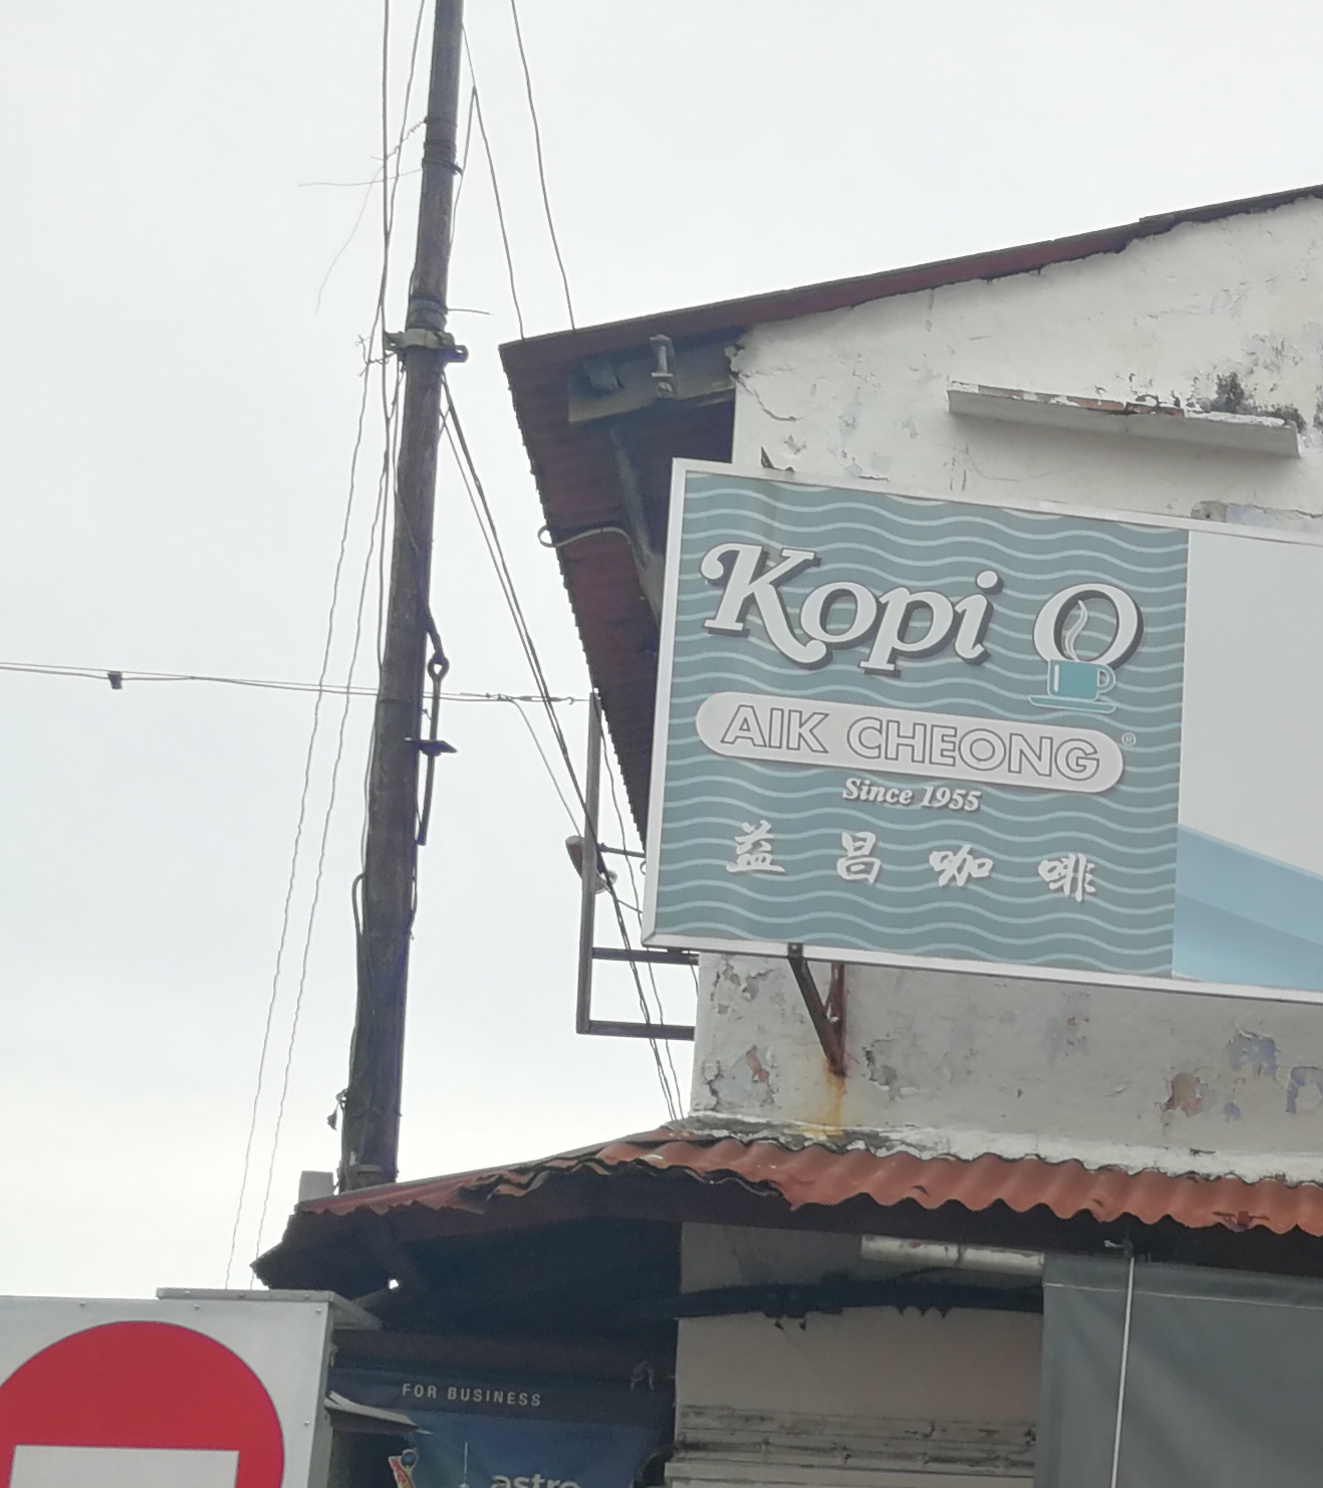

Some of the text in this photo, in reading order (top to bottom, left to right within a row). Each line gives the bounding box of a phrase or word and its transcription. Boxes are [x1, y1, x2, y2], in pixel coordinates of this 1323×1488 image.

[701, 542, 1141, 673] Kopi O
[721, 705, 1100, 780] AIK CHEONG
[842, 778, 981, 812] Since 1955
[402, 1383, 541, 1407] FOR BUSINESS
